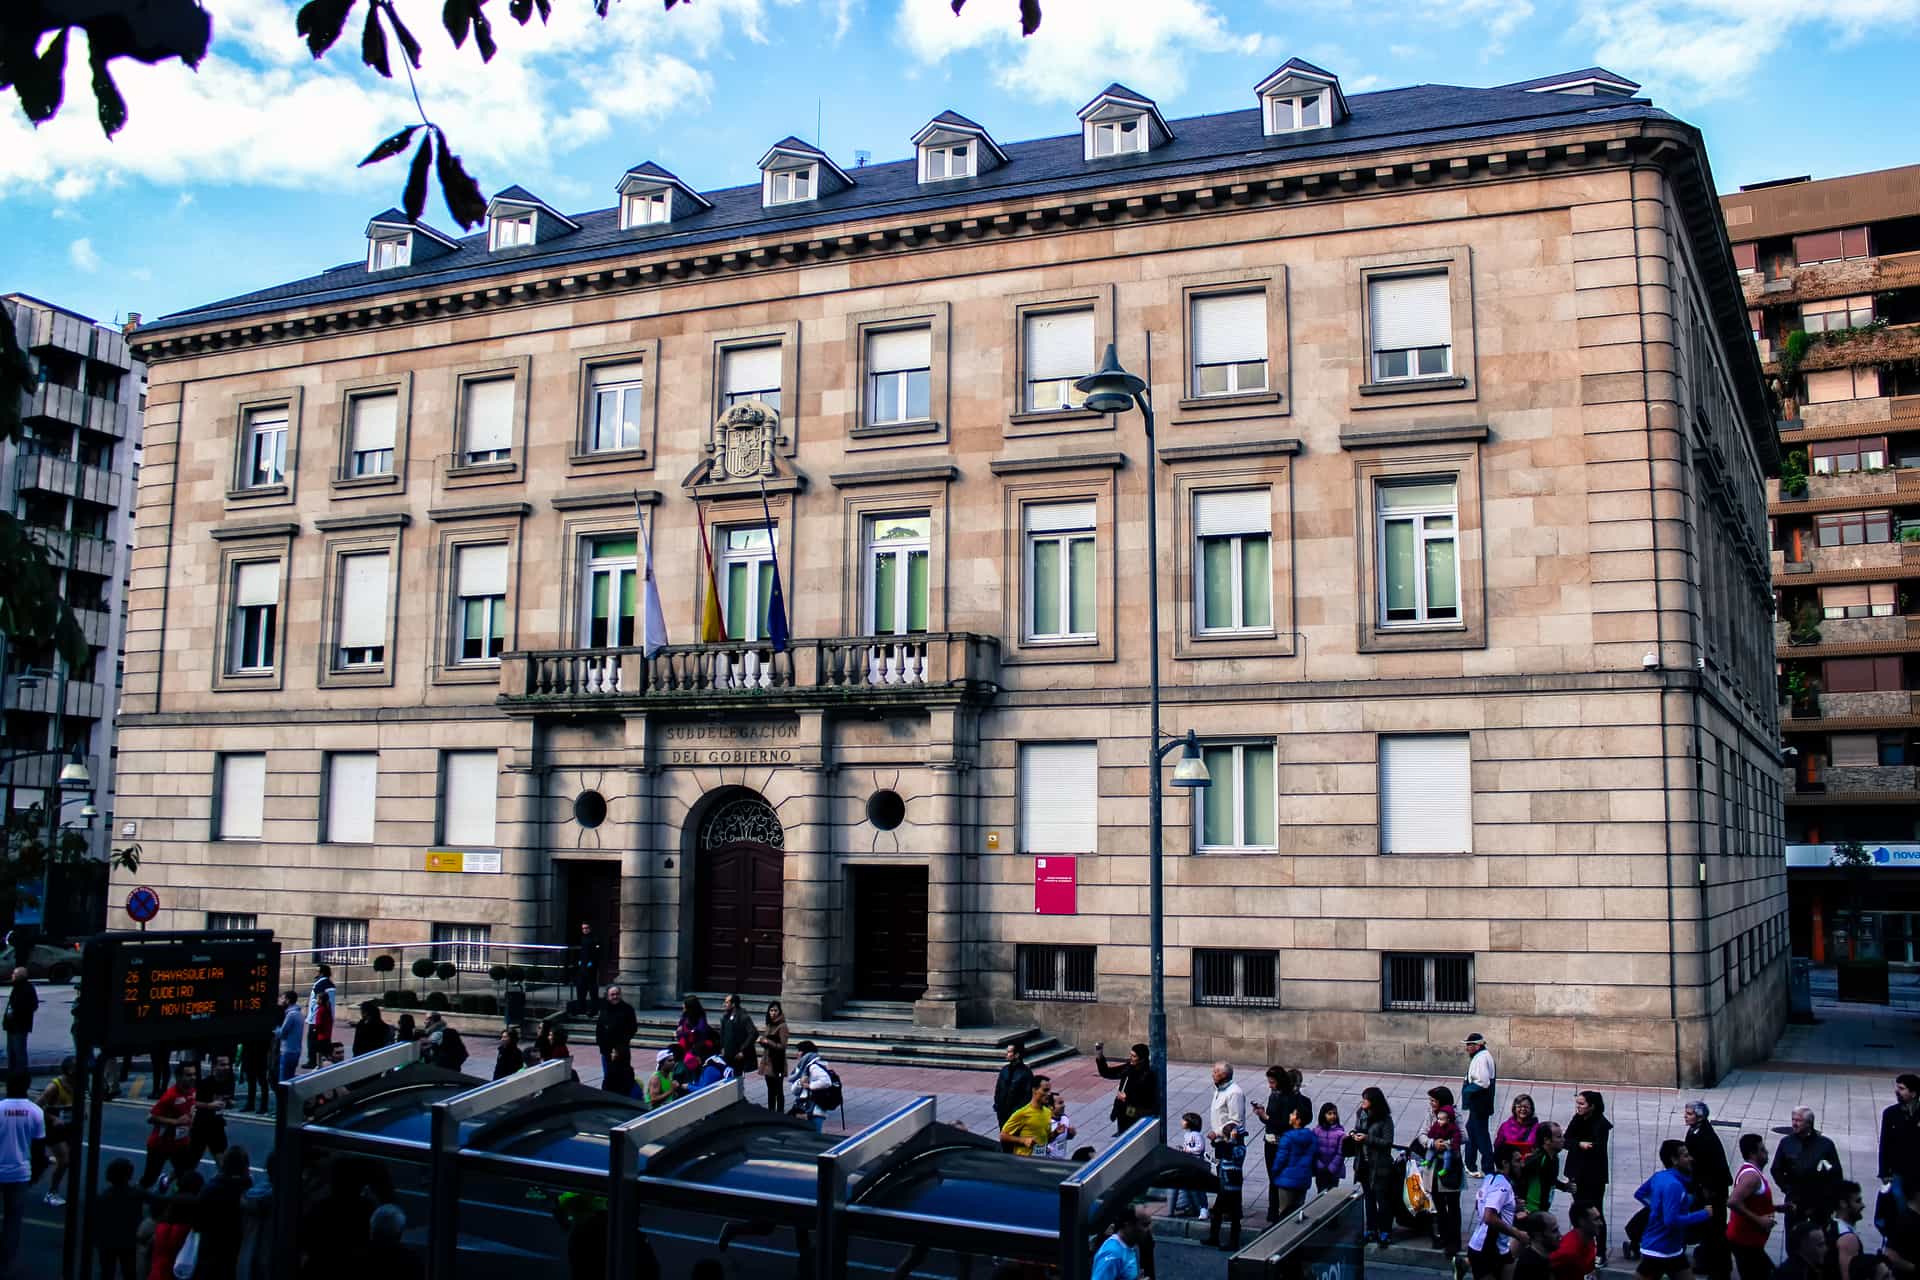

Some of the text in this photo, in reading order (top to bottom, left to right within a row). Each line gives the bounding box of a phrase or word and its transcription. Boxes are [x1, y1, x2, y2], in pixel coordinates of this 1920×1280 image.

[666, 724, 798, 740] SUBDELEGACIÓN
[672, 750, 791, 763] DEL GOBIERNO
[125, 972, 140, 983] 26
[125, 988, 138, 1001] 22
[137, 1005, 152, 1017] 17
[161, 1001, 216, 1015] NOVIEMBRE
